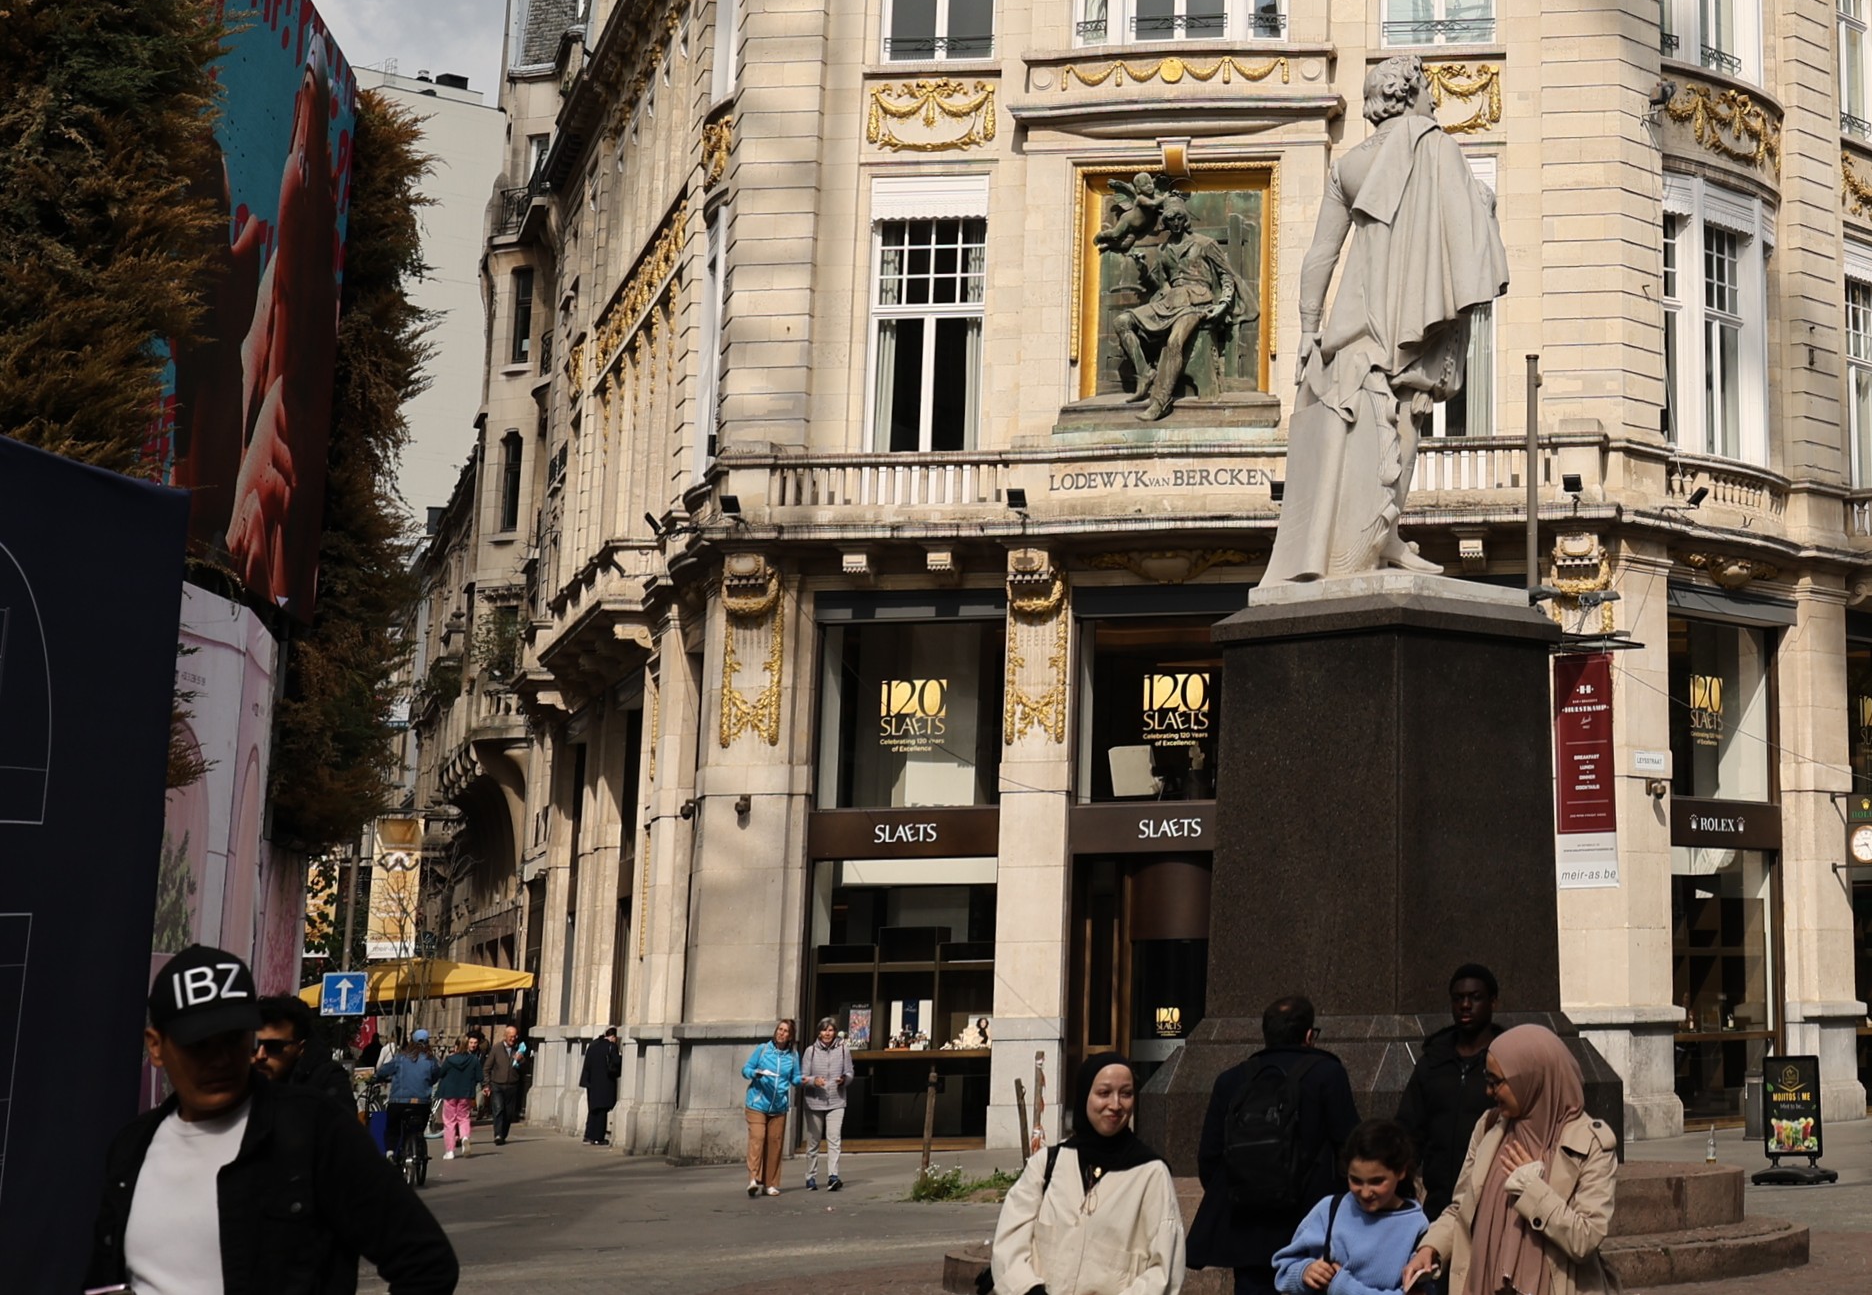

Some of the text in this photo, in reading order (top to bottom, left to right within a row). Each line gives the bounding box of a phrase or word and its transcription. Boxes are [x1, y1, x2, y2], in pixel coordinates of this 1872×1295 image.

[1049, 471, 1150, 492] LODEWYK
[1172, 469, 1276, 487] BERCKEN
[881, 679, 947, 717] 120
[1143, 673, 1210, 711] 120
[1690, 674, 1723, 714] 120
[880, 717, 945, 736] SLAETS
[1143, 711, 1209, 730] SLAETS
[1690, 710, 1724, 731] SLAETS
[1636, 757, 1663, 765] LEYSSTRAAT
[874, 823, 937, 843] SLAETS
[1138, 818, 1201, 839] SLAETS
[1700, 817, 1735, 832] ROLEX
[1561, 868, 1617, 880] meir-as.be
[173, 963, 248, 1009] IBZ
[1773, 1092, 1796, 1101] MOJITOS
[1801, 1092, 1811, 1101] ME
